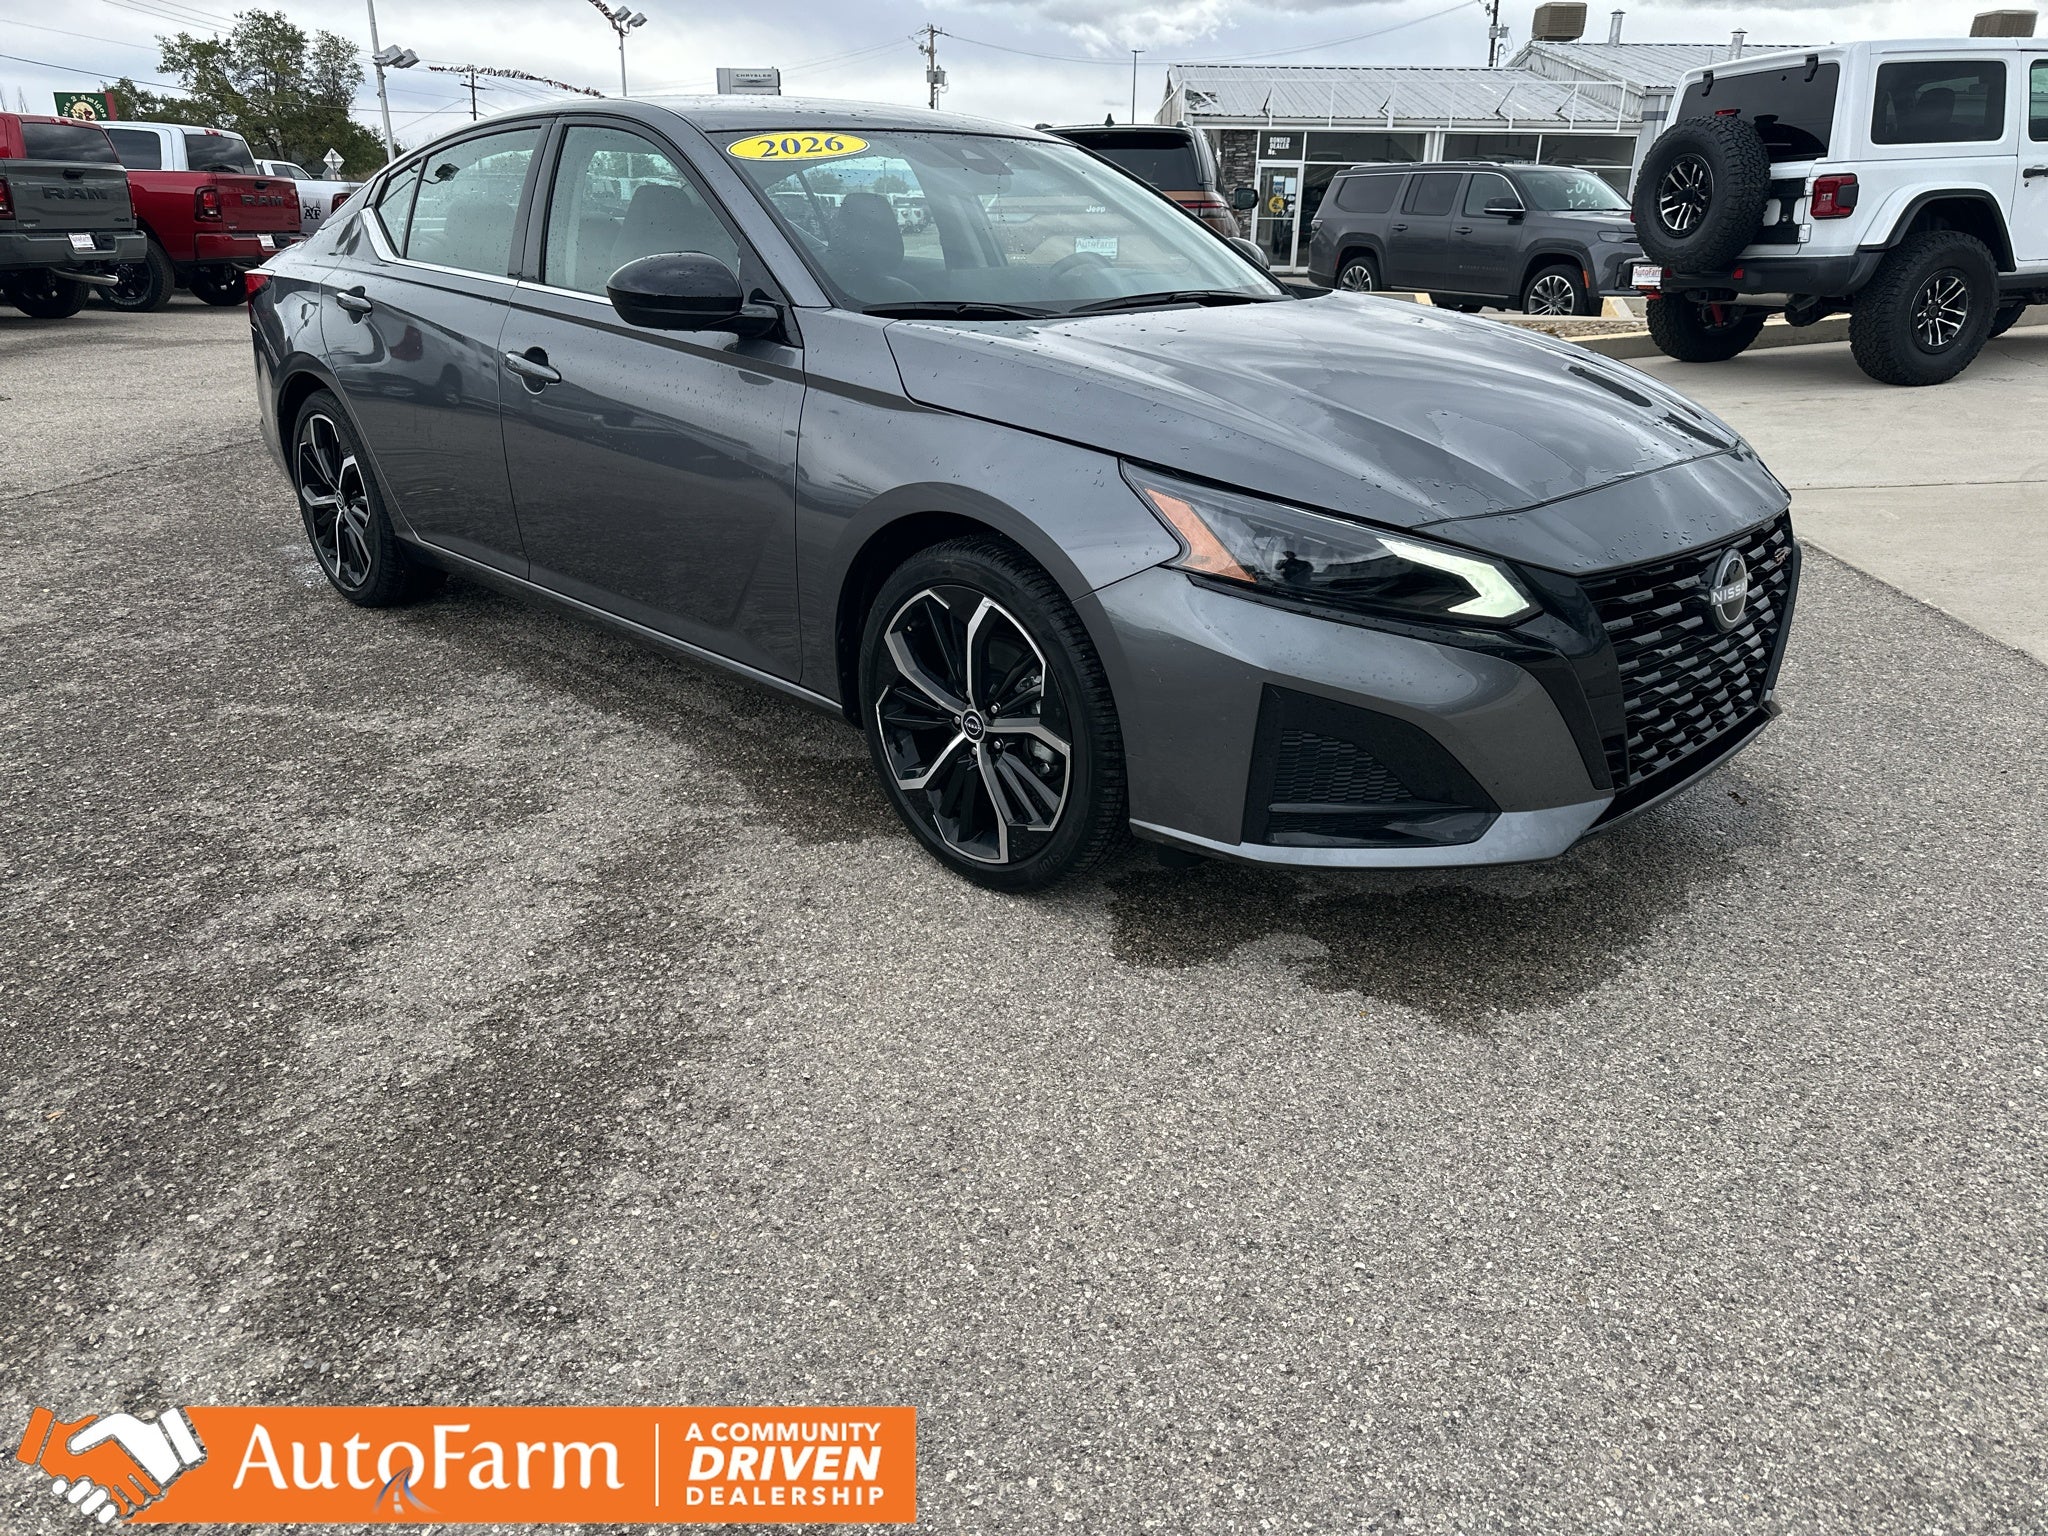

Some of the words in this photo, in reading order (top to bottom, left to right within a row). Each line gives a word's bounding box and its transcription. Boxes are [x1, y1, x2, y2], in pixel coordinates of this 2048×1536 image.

[80, 94, 107, 118] Amigos
[757, 136, 844, 157] 2026
[42, 186, 108, 200] RAM
[241, 194, 283, 207] RAM
[1086, 205, 1106, 213] Jeep
[1712, 582, 1746, 603] NISSA
